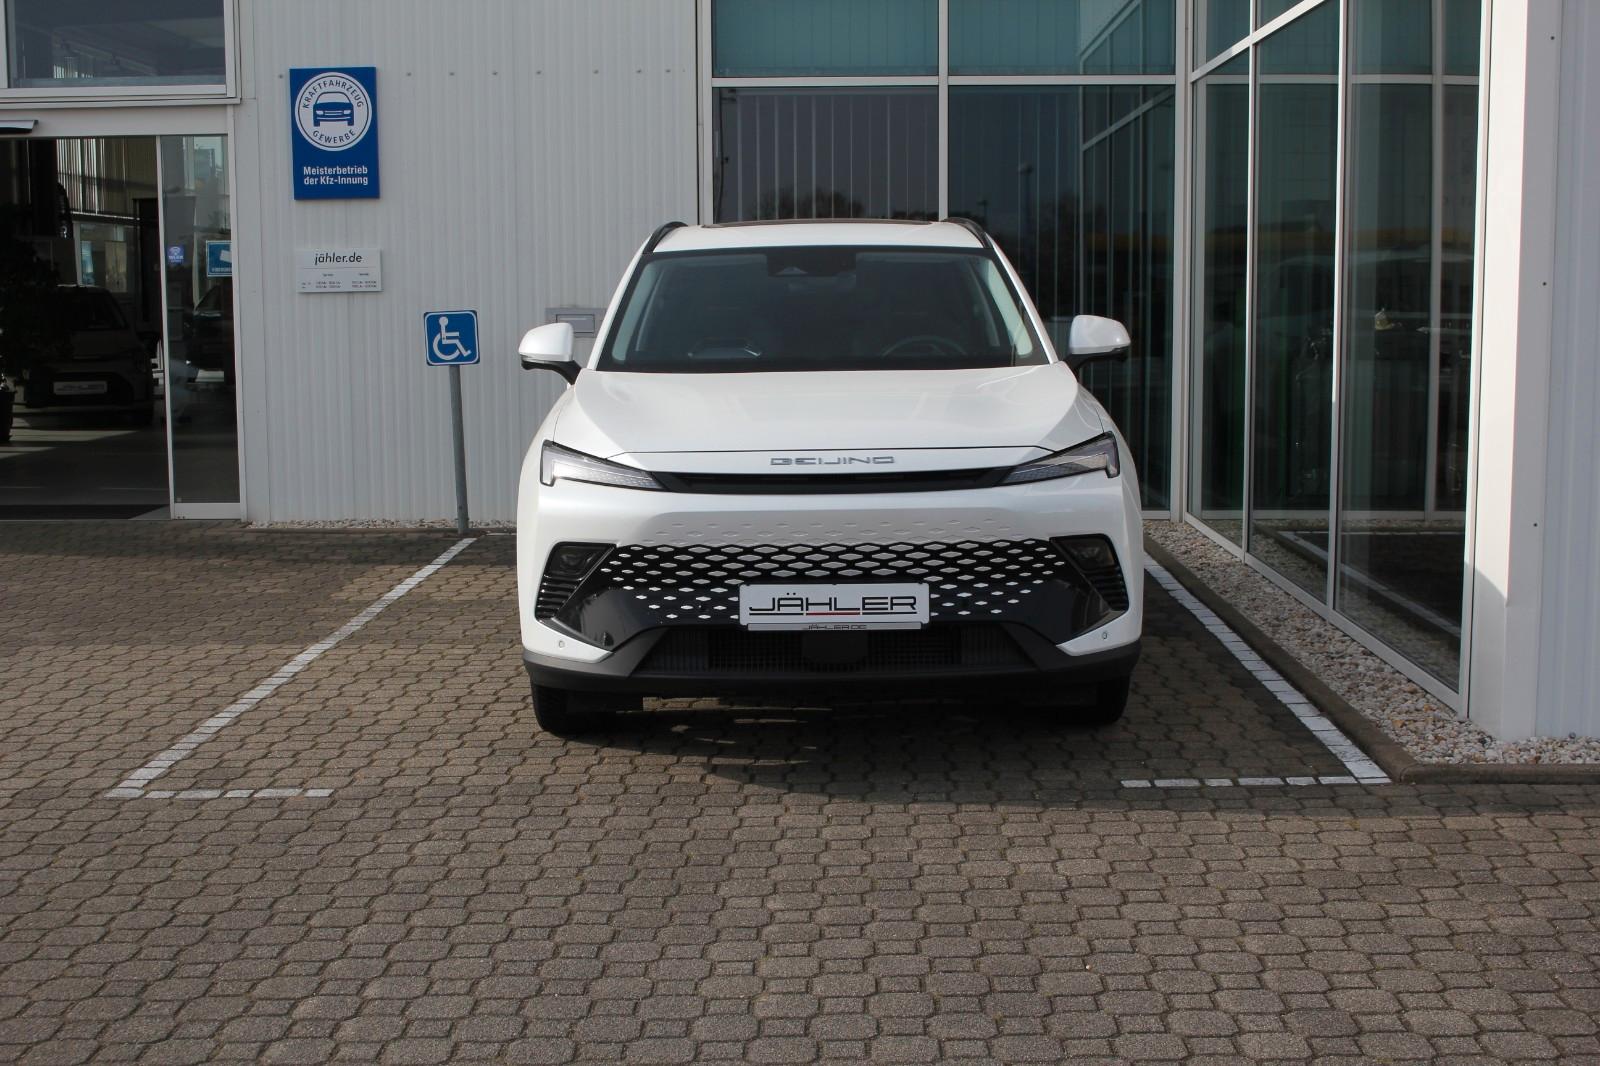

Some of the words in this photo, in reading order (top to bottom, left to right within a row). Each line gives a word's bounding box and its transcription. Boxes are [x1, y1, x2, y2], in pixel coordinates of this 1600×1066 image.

[302, 79, 365, 109] KRAFTFAHRZEUG
[312, 128, 356, 144] GEWERBE
[303, 165, 368, 175] Meisterbetrieb
[303, 176, 318, 185] der
[320, 176, 368, 186] Kfz-Innung
[314, 252, 363, 266] jähler.de
[770, 456, 895, 466] BEIJING
[749, 592, 917, 612] JÄHLER
